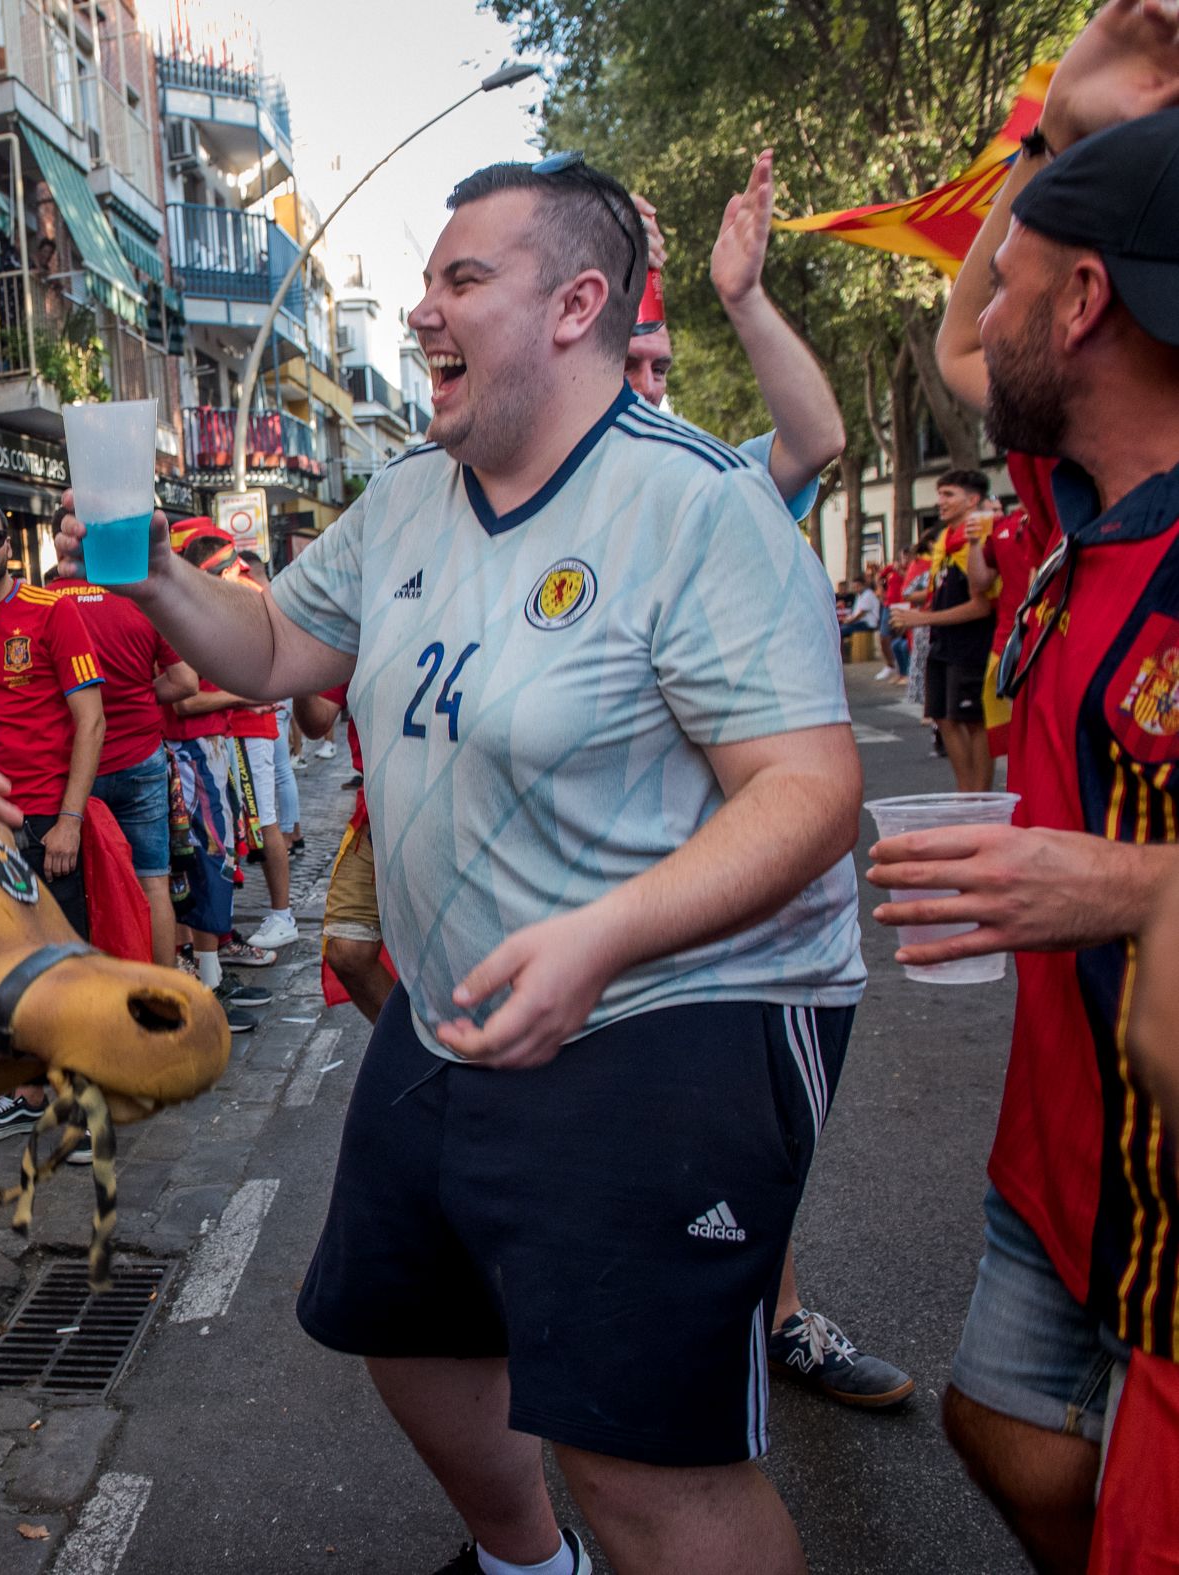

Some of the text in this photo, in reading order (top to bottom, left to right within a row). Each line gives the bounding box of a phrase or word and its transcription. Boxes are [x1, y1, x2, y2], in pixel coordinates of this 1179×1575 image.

[77, 594, 103, 603] FANS
[403, 642, 480, 742] 24
[687, 1223, 746, 1242] adidas
